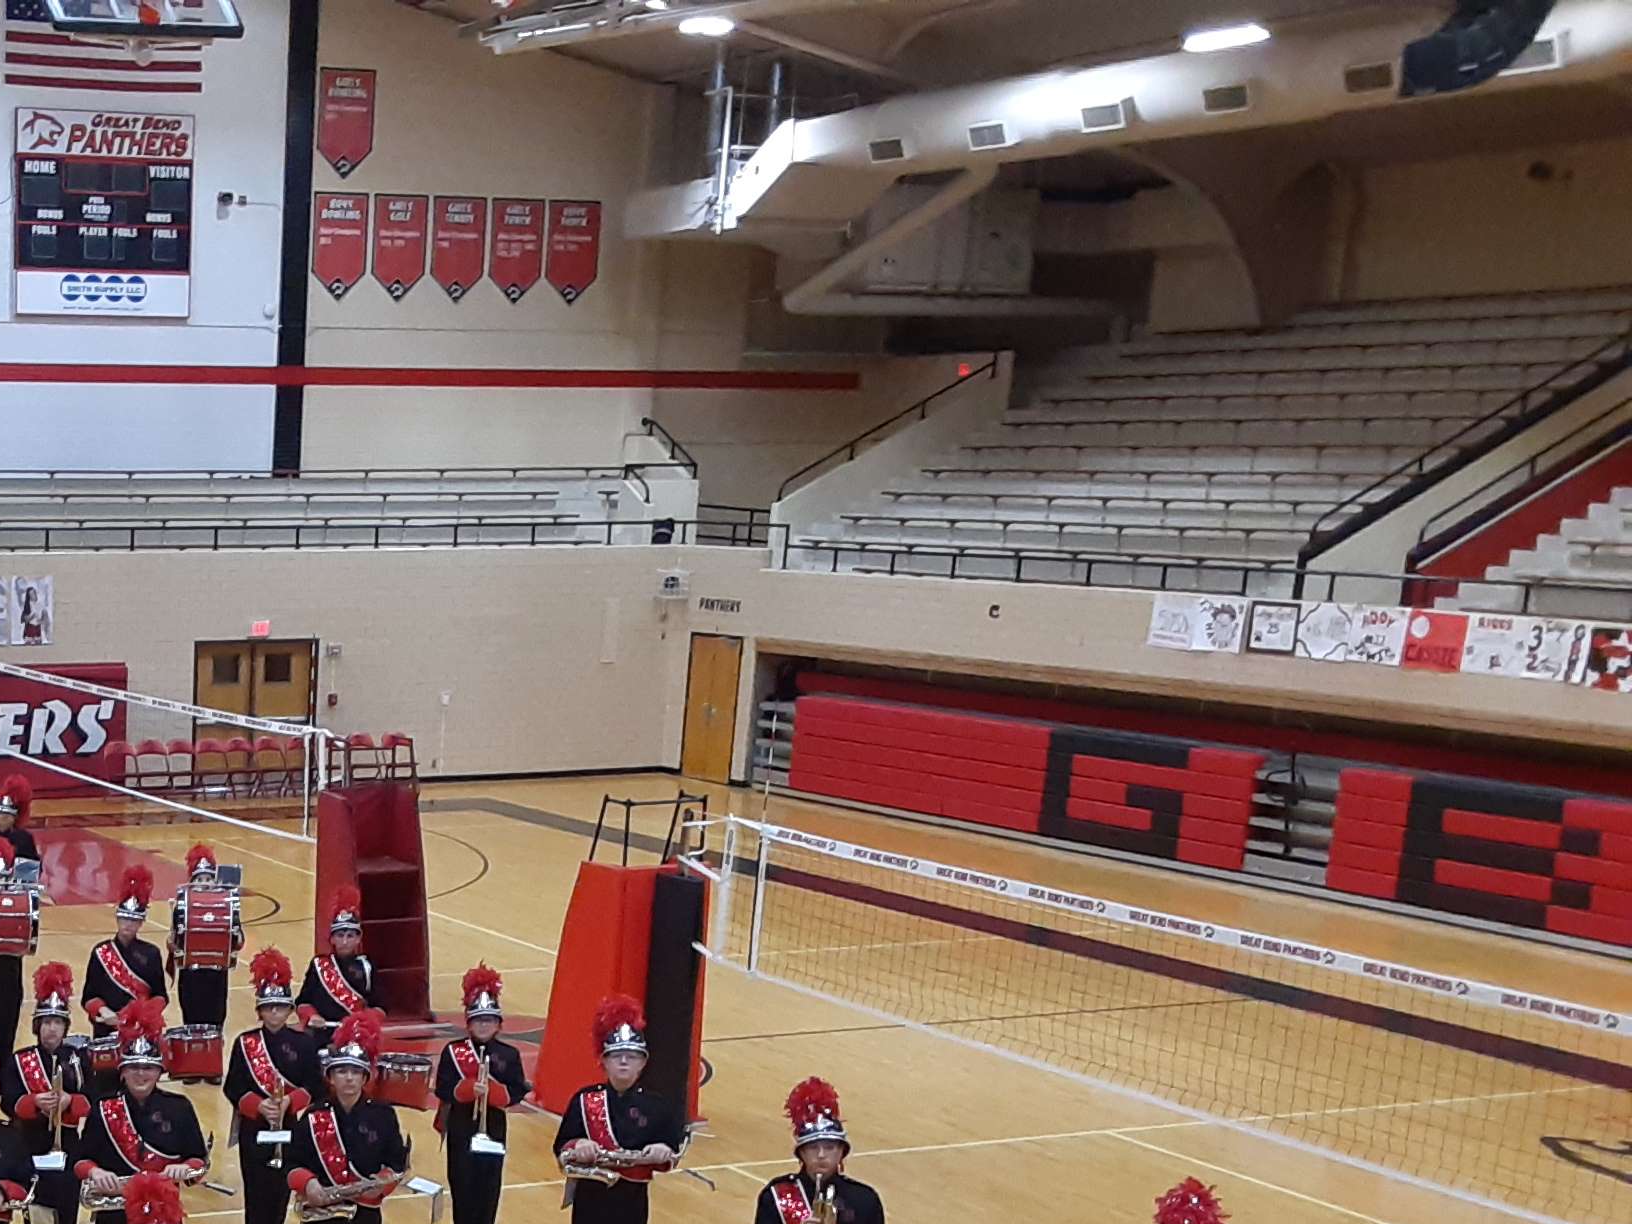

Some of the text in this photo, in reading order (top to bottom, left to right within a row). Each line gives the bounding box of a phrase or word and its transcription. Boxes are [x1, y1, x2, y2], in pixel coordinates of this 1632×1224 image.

[91, 114, 182, 131] GREAT BEND
[66, 123, 190, 157] PANTHERS
[24, 160, 56, 174] HOME
[149, 165, 190, 179] VISITOR
[32, 225, 57, 235] FOULS
[78, 227, 138, 238] PLAYER FOULS
[152, 229, 178, 239] FOULS
[94, 286, 124, 294] SUPPLY
[698, 596, 742, 613] PANTHERS
[1528, 625, 1543, 652] 3
[1038, 725, 1190, 862] G
[1129, 910, 1201, 935] GREAT BEND PANTHERS
[1240, 934, 1321, 961] GREAT BEND PANTHERS
